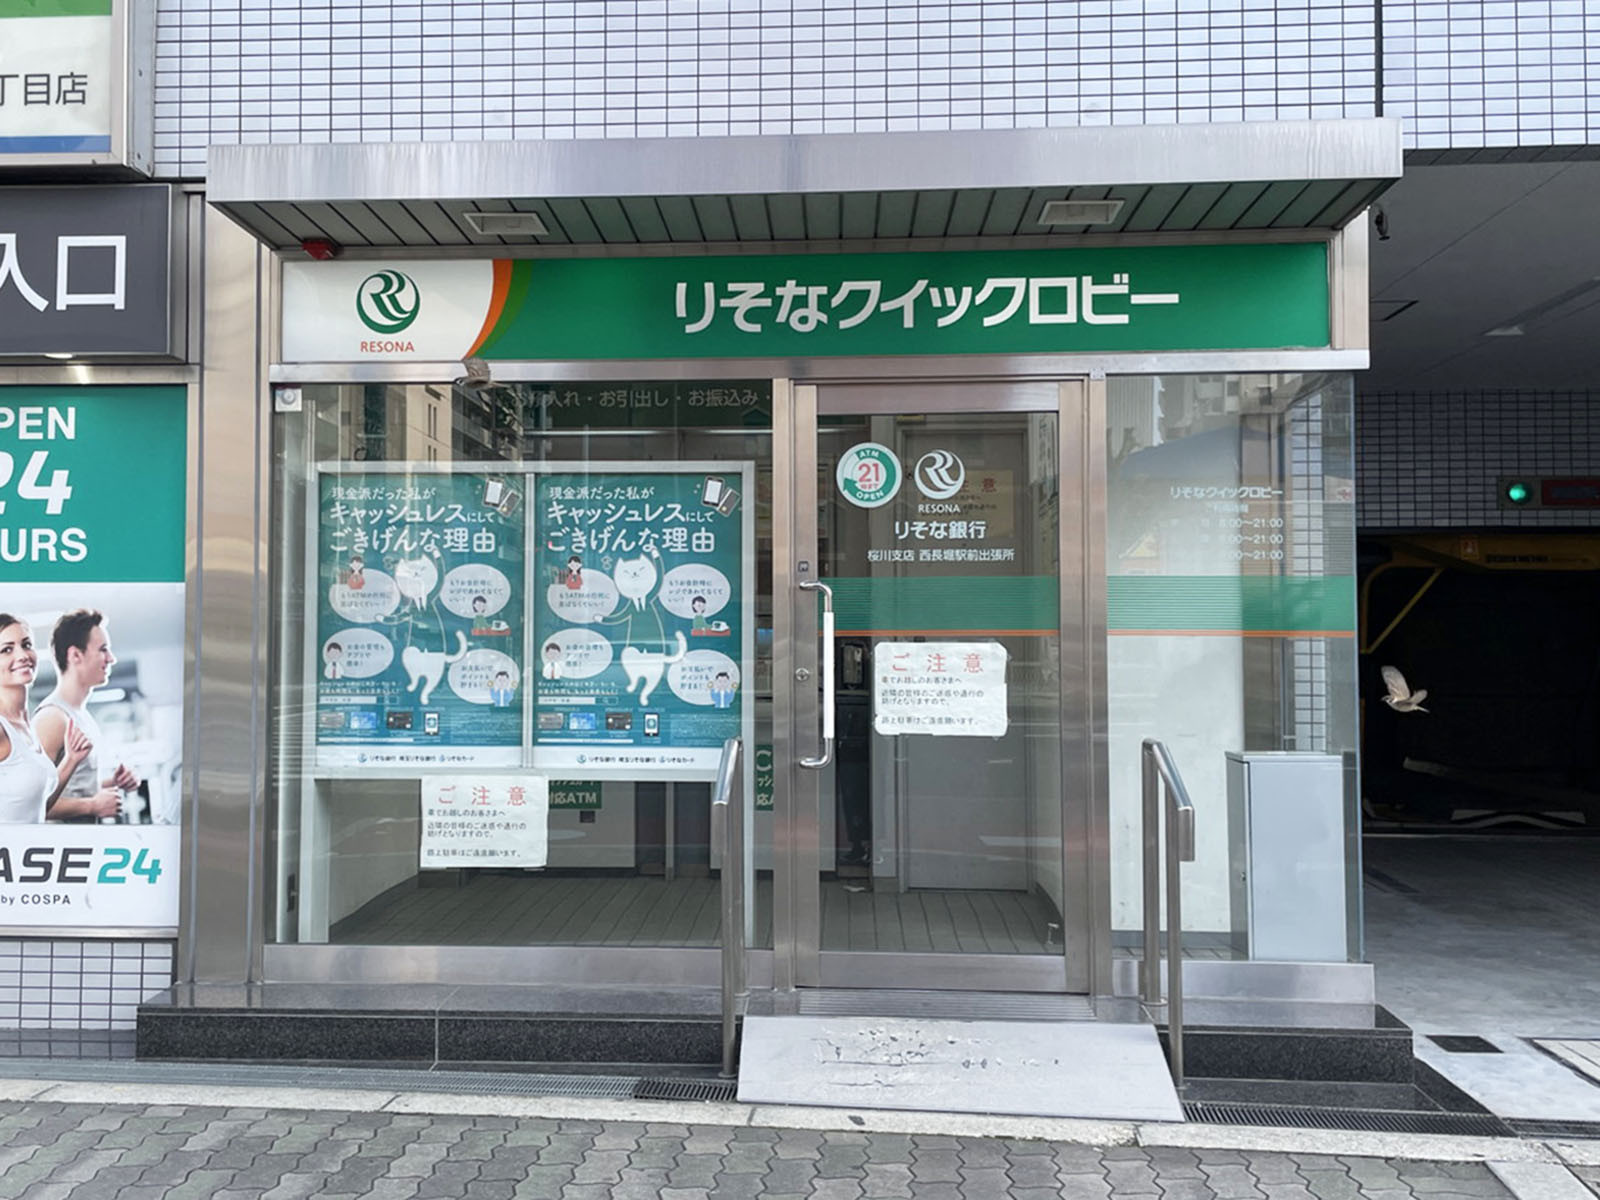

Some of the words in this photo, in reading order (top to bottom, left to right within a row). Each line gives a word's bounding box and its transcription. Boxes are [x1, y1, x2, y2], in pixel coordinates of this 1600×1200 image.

[674, 272, 1180, 333] りそなクイックロビー
[360, 341, 415, 353] RESONA
[859, 449, 880, 458] ATM
[858, 462, 880, 483] 21
[331, 486, 437, 500] 現金派だった私が
[549, 486, 655, 500] 現金派だった私が
[856, 490, 884, 500] OPEN
[1170, 486, 1283, 498] りそなクイックロビー
[330, 501, 496, 524] キャッシュレスにして
[547, 500, 715, 524] キャッシュレスにして
[918, 503, 961, 513] RESONA
[894, 520, 987, 540] りそな銀行
[330, 526, 495, 553] ごきげんな理由
[547, 525, 716, 553] ごきげんな理由
[867, 549, 915, 562] 桜川支店
[892, 653, 984, 673] ご注意
[439, 786, 527, 806] ご注意
[1, 894, 15, 906] by
[21, 894, 71, 905] COSPA
